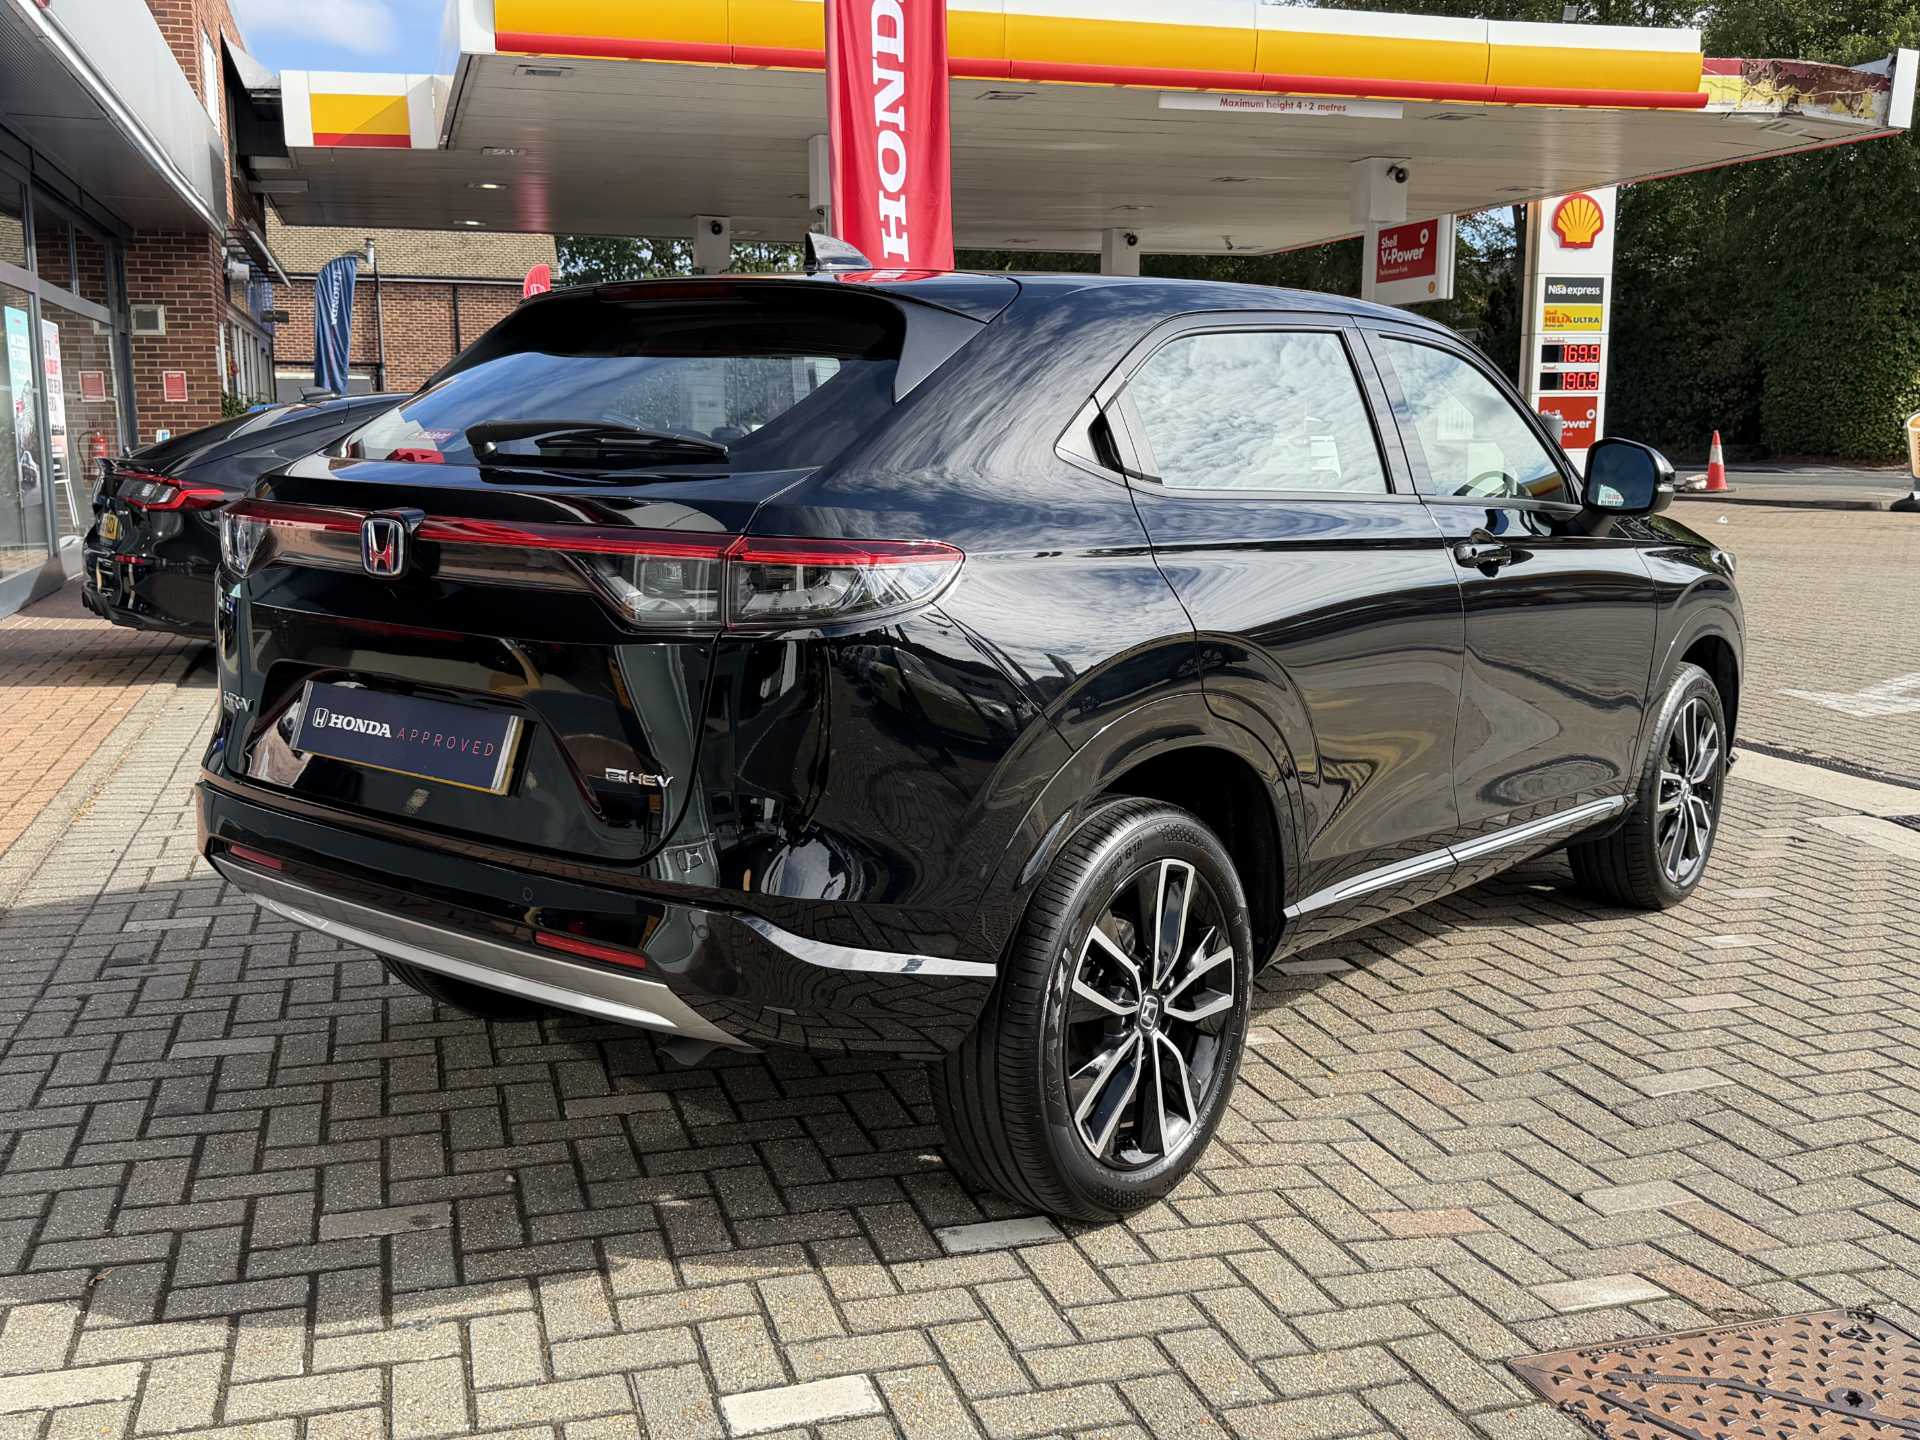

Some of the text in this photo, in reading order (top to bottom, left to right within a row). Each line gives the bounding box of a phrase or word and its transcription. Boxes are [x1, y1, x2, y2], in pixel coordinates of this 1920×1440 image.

[1219, 97, 1264, 108] Maximum
[1266, 99, 1294, 111] height
[1317, 103, 1347, 112] metres
[871, 0, 910, 262] HOND
[1381, 232, 1398, 249] Shell
[1381, 247, 1425, 266] V-Power
[1567, 286, 1601, 296] express
[1563, 345, 1600, 362] 169.9
[1562, 372, 1598, 390] 190.9
[328, 712, 494, 757] HONDA APPROVED
